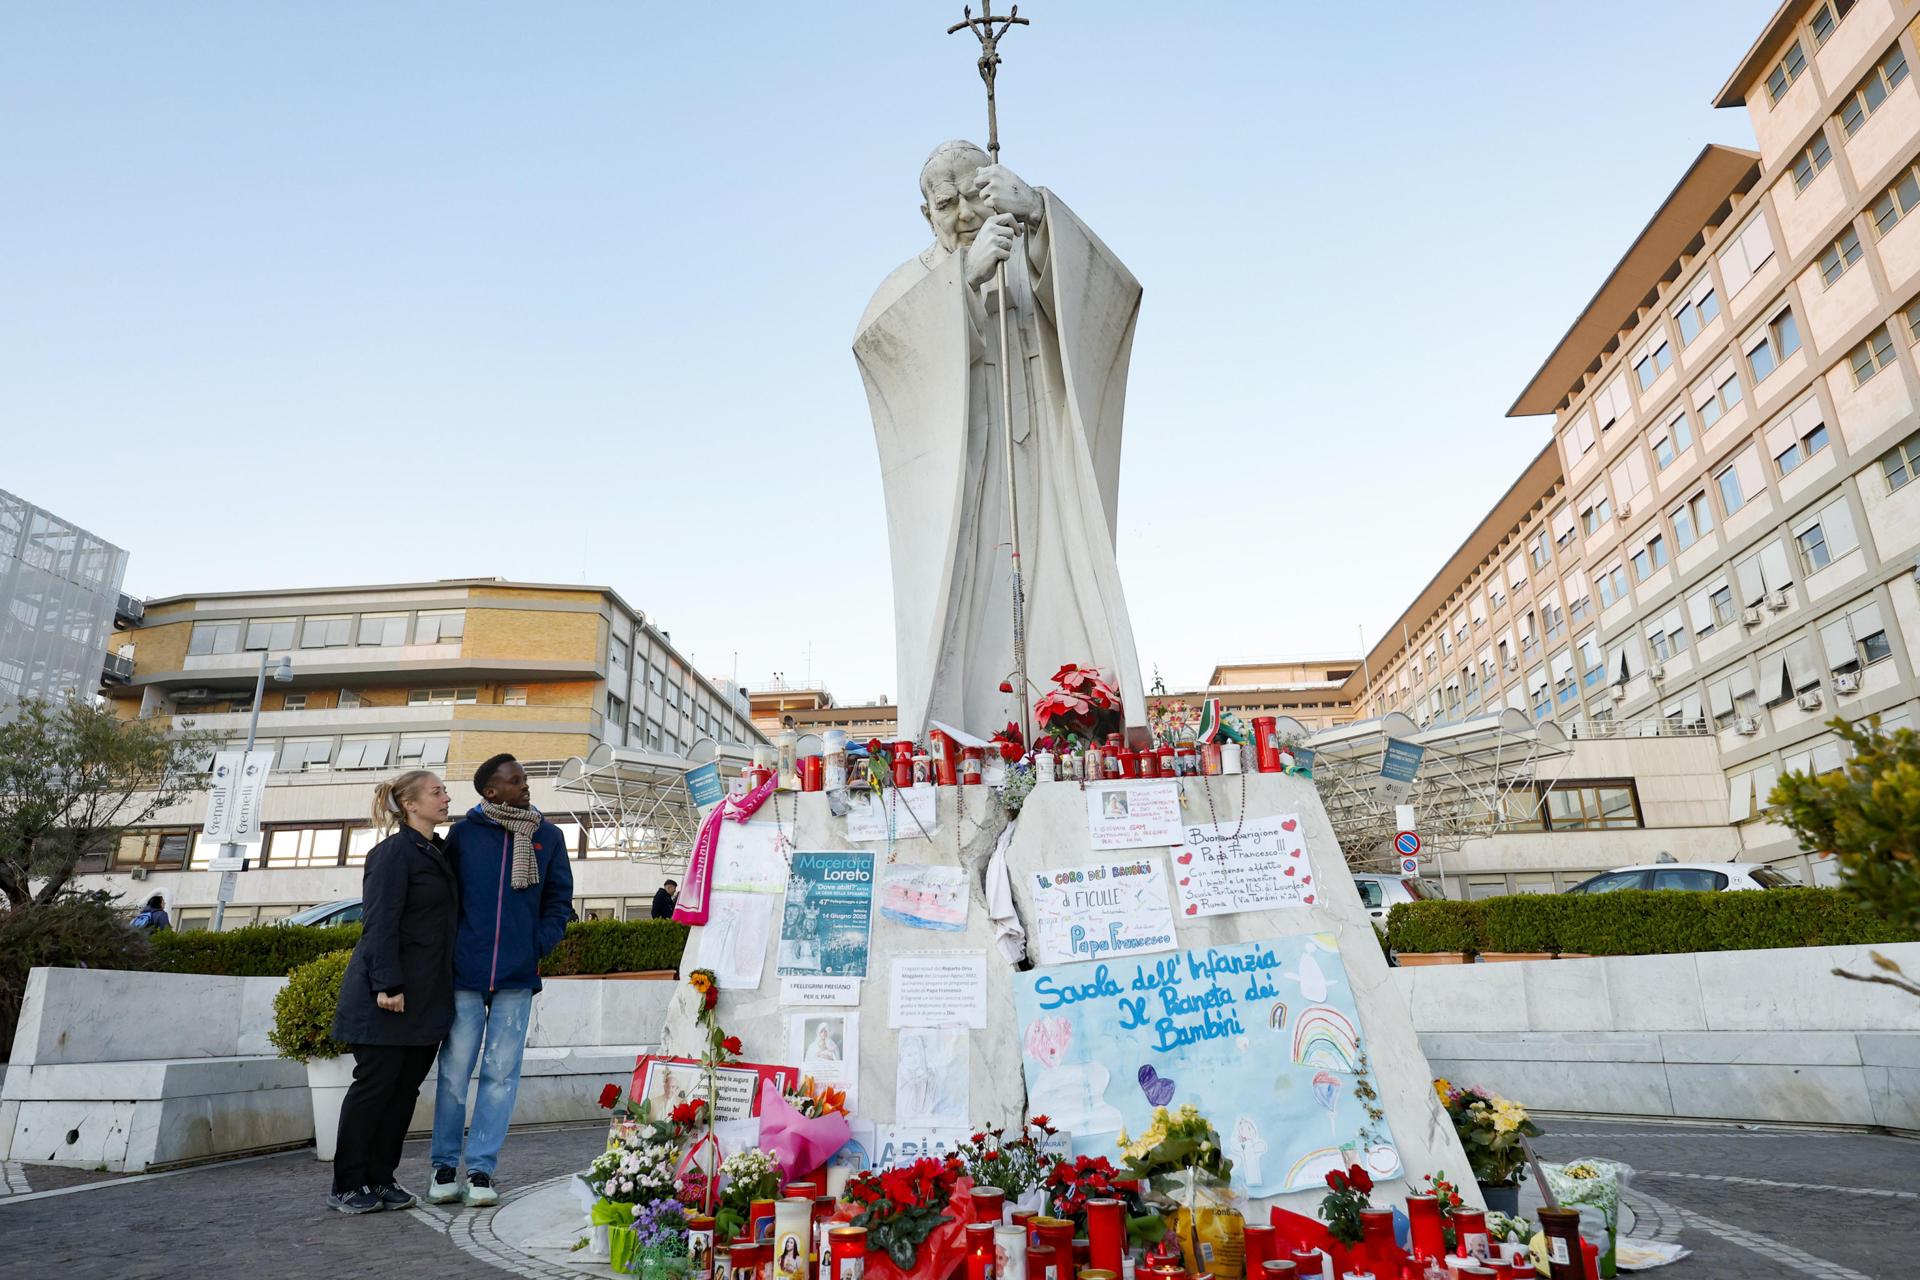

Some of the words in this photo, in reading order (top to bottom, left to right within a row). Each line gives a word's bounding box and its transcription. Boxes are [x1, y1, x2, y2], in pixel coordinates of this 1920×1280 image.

[207, 786, 227, 836] Gemelli
[236, 785, 254, 834] Gemelli
[799, 855, 872, 869] Macerata
[823, 868, 870, 882] Loreto
[1054, 869, 1084, 885] CORO
[1062, 892, 1071, 907] di
[1075, 887, 1121, 908] FICULLE
[1070, 924, 1109, 959] Papa
[1108, 921, 1171, 951] Francesco
[1034, 964, 1124, 1010] Scuola
[1131, 954, 1182, 991] dell'
[1187, 943, 1282, 982] Infanzia
[1158, 981, 1237, 1017] Pianeta
[1244, 971, 1281, 1002] dei
[1151, 1007, 1246, 1052] Bambini
